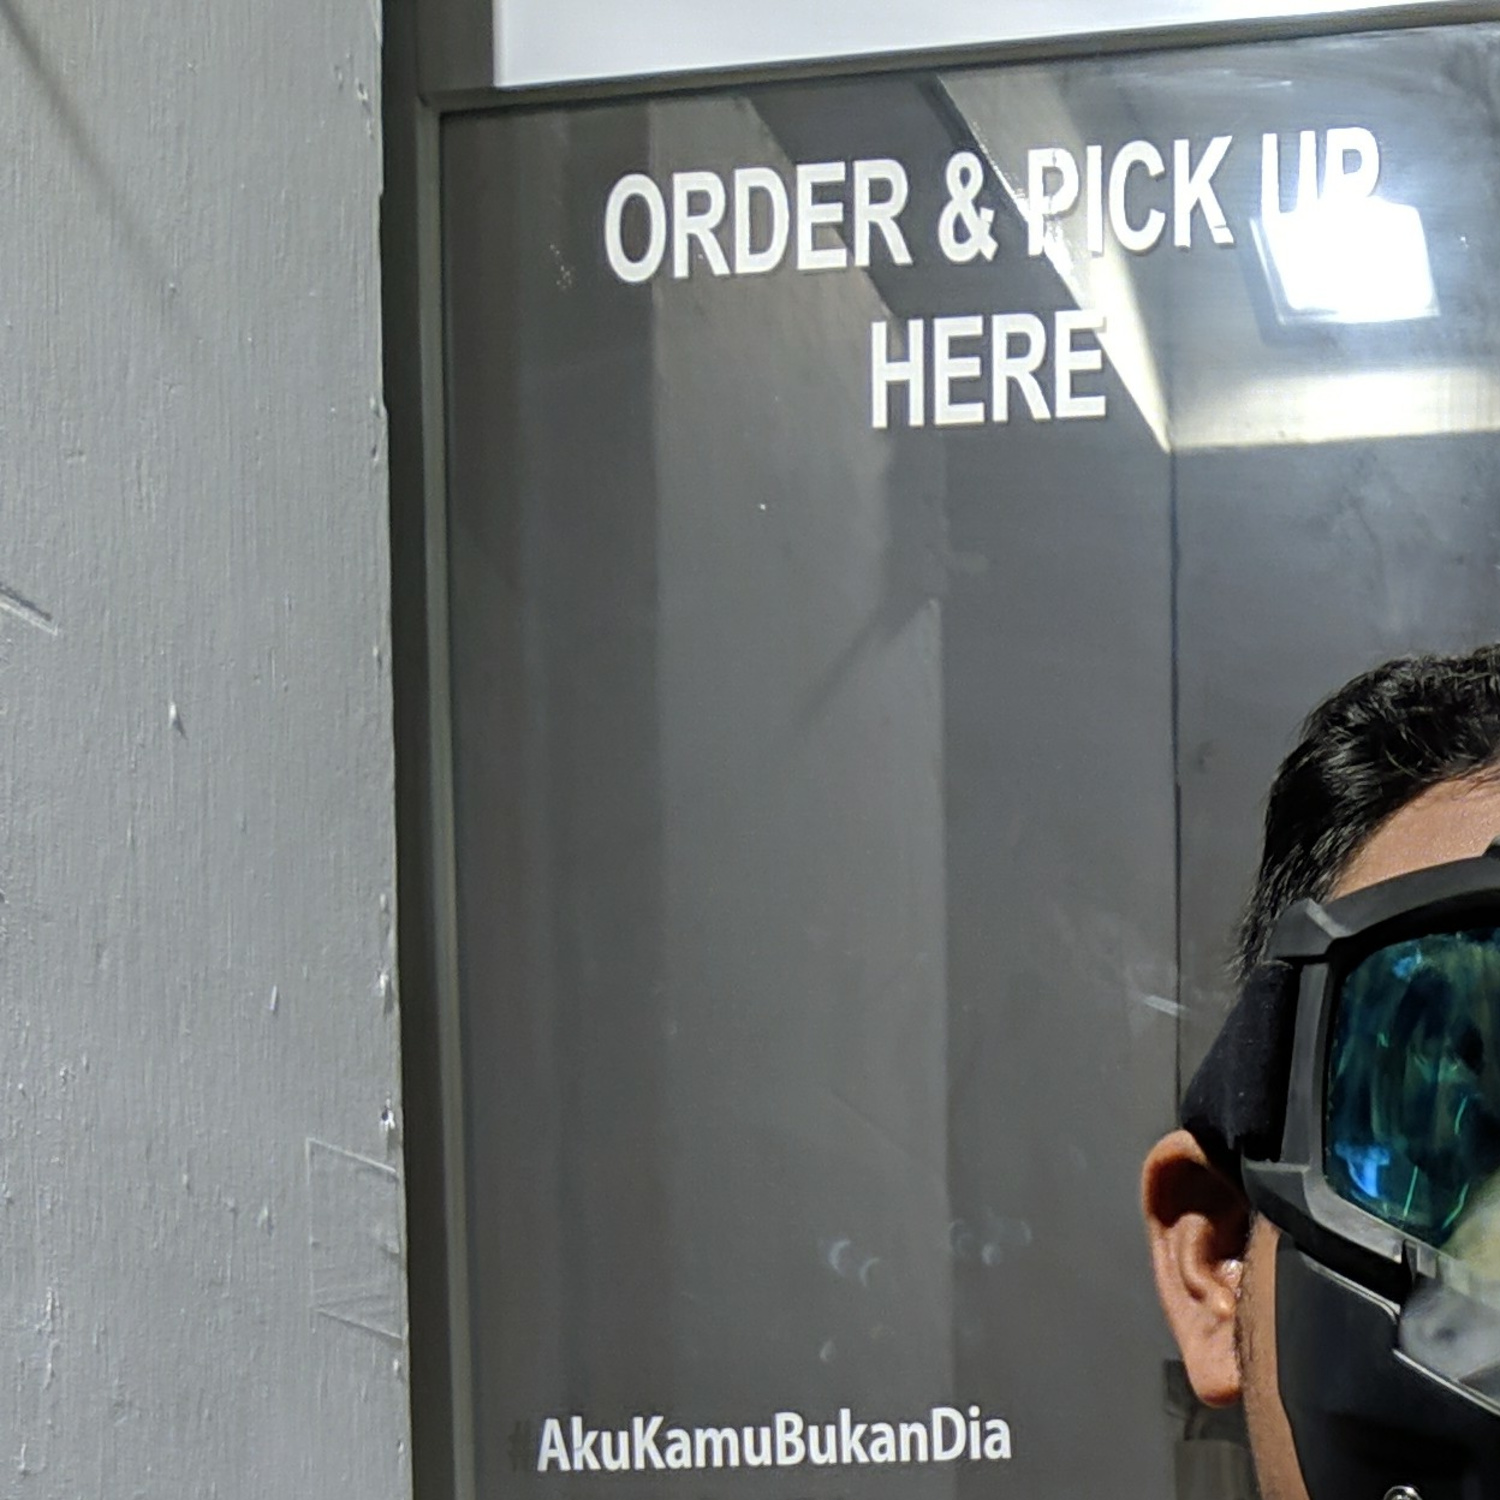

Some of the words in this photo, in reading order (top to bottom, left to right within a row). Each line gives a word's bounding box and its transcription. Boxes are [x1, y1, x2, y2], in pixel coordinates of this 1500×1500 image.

[604, 158, 914, 283] ORDER
[938, 151, 998, 262] &
[1027, 134, 1235, 257] PICK
[1260, 126, 1381, 240] UP
[870, 308, 1108, 430] HERE
